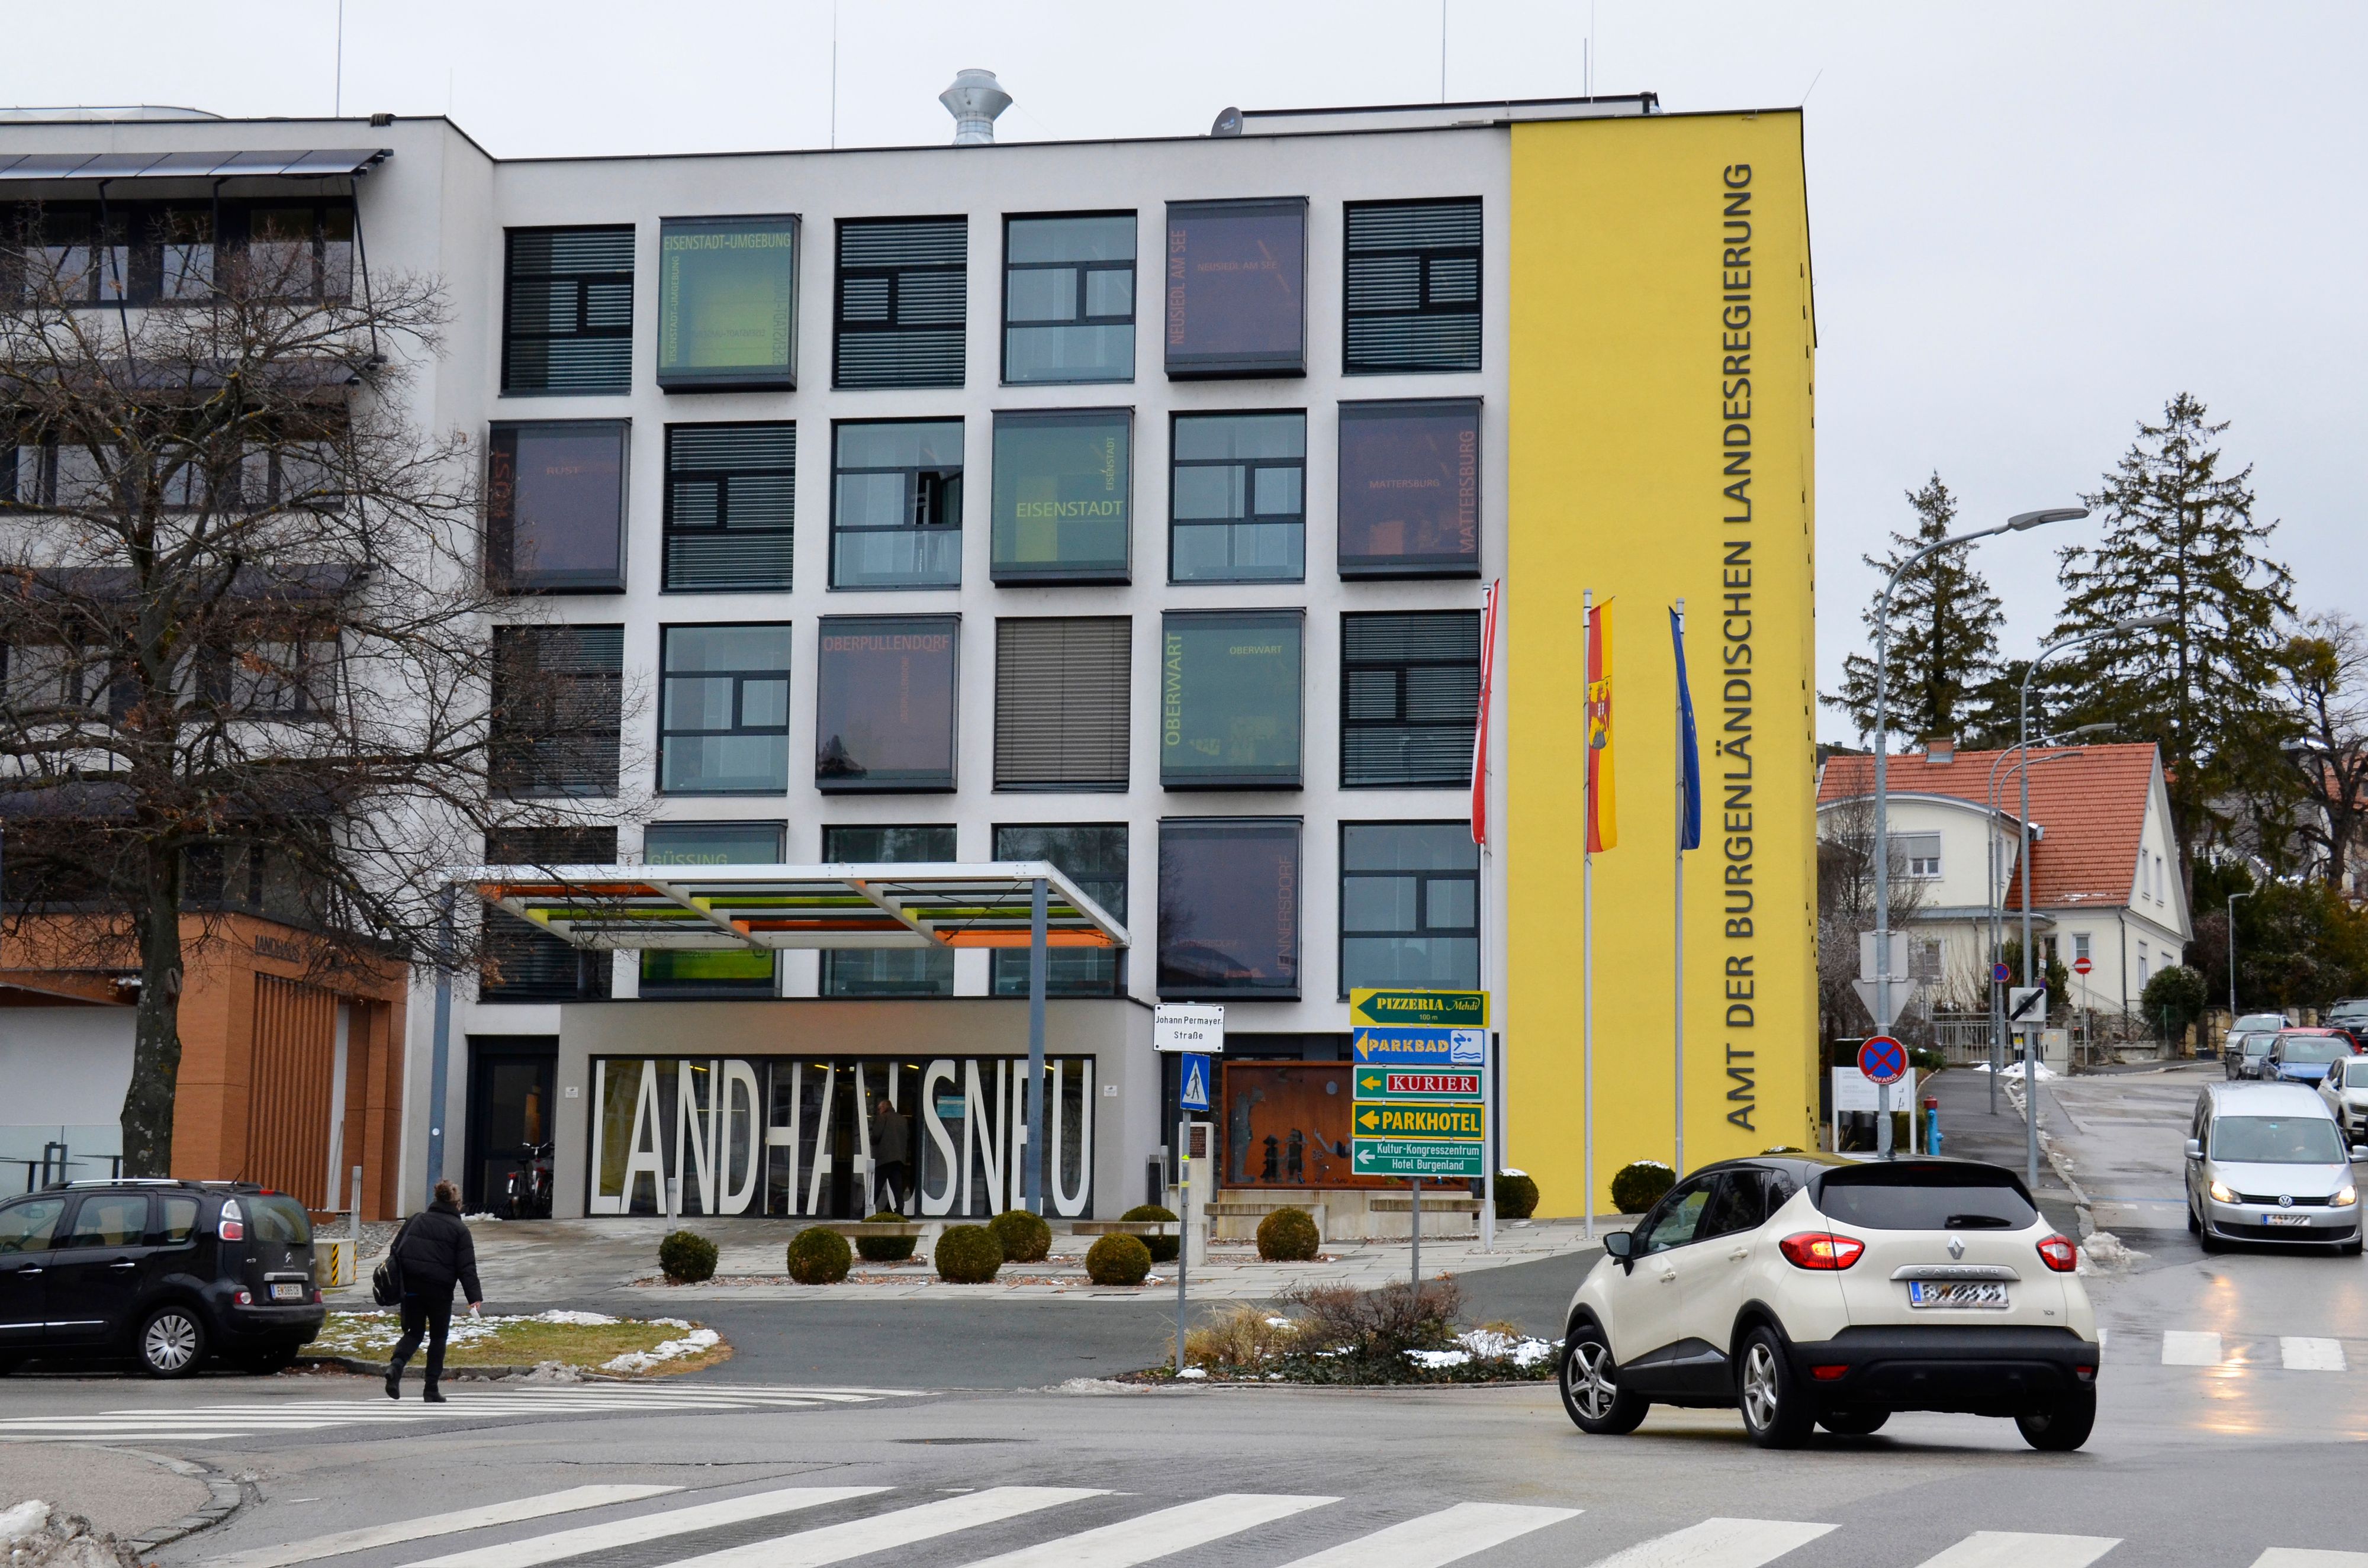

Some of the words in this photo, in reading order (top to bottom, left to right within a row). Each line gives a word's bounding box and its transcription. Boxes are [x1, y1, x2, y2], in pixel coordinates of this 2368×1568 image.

[664, 233, 791, 250] EISENSTADT-UMGEBUNG
[1172, 230, 1186, 253] SEE
[1172, 257, 1185, 279] AM
[1198, 262, 1239, 271] NEUSIEDL
[1244, 262, 1259, 270] AM
[670, 256, 680, 362] EISENSTADT-UMGEBUNG
[1170, 283, 1185, 344] NEUSIEDL
[1723, 165, 1751, 522] LANDESREGIERUNG
[546, 466, 580, 475] RUST
[1106, 436, 1114, 491] EISENSTADT
[1369, 479, 1440, 488] MATTERSBURG
[1459, 431, 1475, 553] MATTERSBURG
[1016, 501, 1123, 517] EISENSTADT
[823, 635, 949, 651] OBERPULLENDORF
[1230, 645, 1282, 655] OBERWART
[1166, 633, 1182, 745] OBERWART
[1716, 542, 1752, 937] BURGENLÄNDISCHEN
[1277, 855, 1294, 975] JENNERSDORF
[1726, 956, 1753, 1026] DER
[1376, 997, 1444, 1010] PIZZERIA
[1175, 1031, 1203, 1039] Straße
[1369, 1039, 1449, 1053] PARKBAD
[1393, 1076, 1472, 1092] KURIER
[1867, 1073, 1898, 1083] ANFANG
[1726, 1044, 1754, 1131] AMT
[1382, 1112, 1479, 1132] PARKHOTEL
[1377, 1143, 1479, 1157] Kultur-Kongresszentrum
[1392, 1159, 1414, 1170] Hotel
[1417, 1160, 1464, 1171] Burgenland
